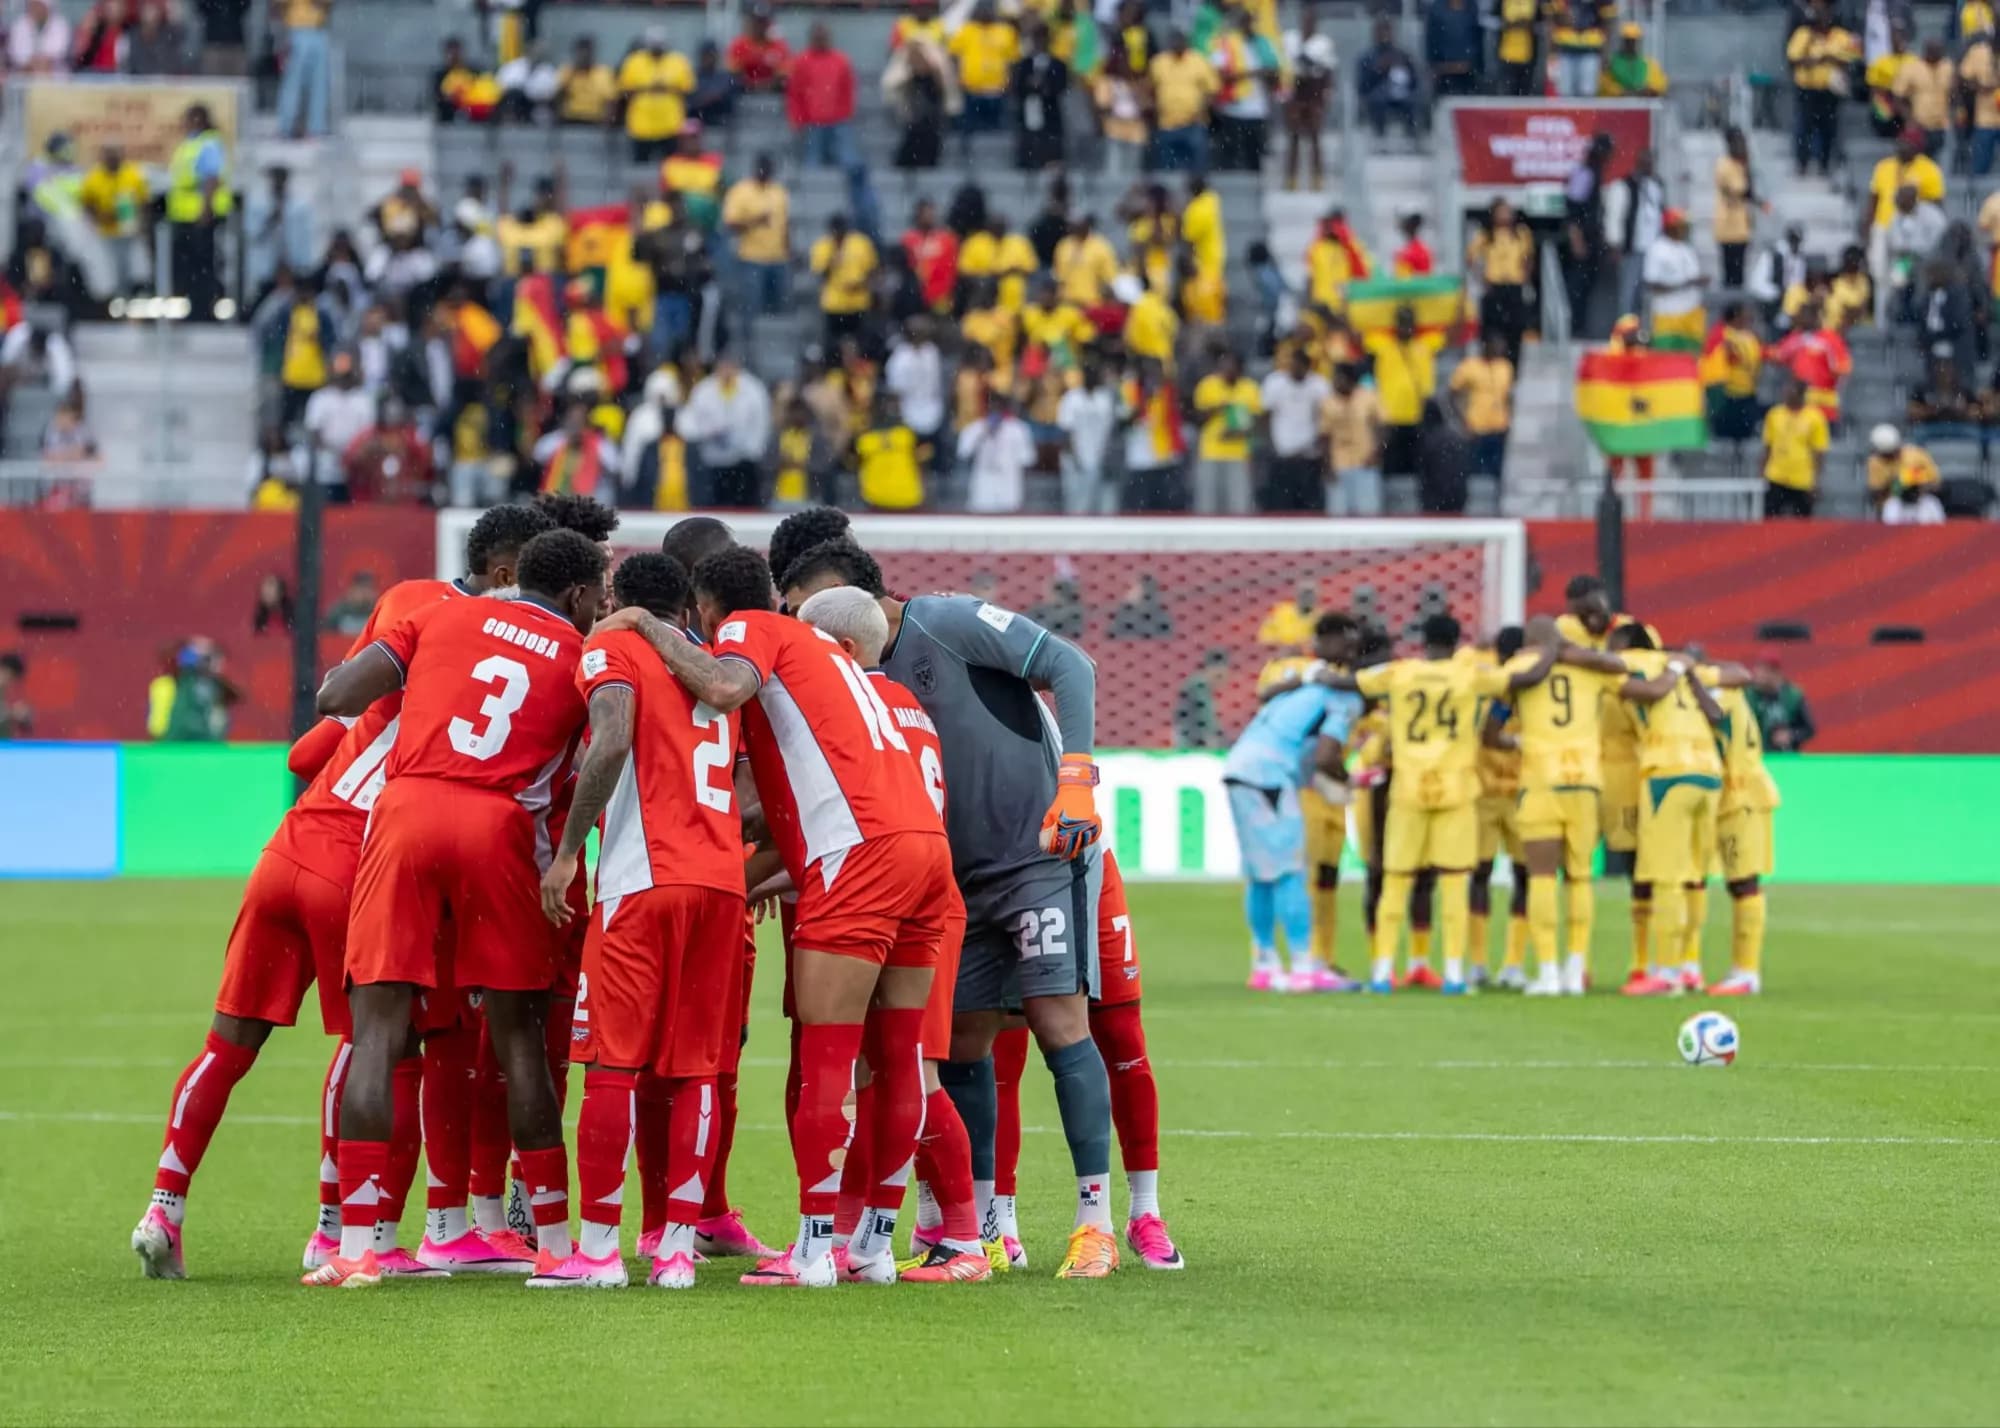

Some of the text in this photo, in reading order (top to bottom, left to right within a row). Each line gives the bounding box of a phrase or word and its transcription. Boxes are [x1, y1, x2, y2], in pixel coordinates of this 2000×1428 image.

[482, 617, 560, 660] CORDOBA
[447, 655, 530, 761] 3
[1406, 689, 1458, 742] 24
[1551, 675, 1571, 726] 9
[692, 699, 732, 814] 2
[1019, 907, 1067, 961] 22
[1112, 915, 1133, 962] 7
